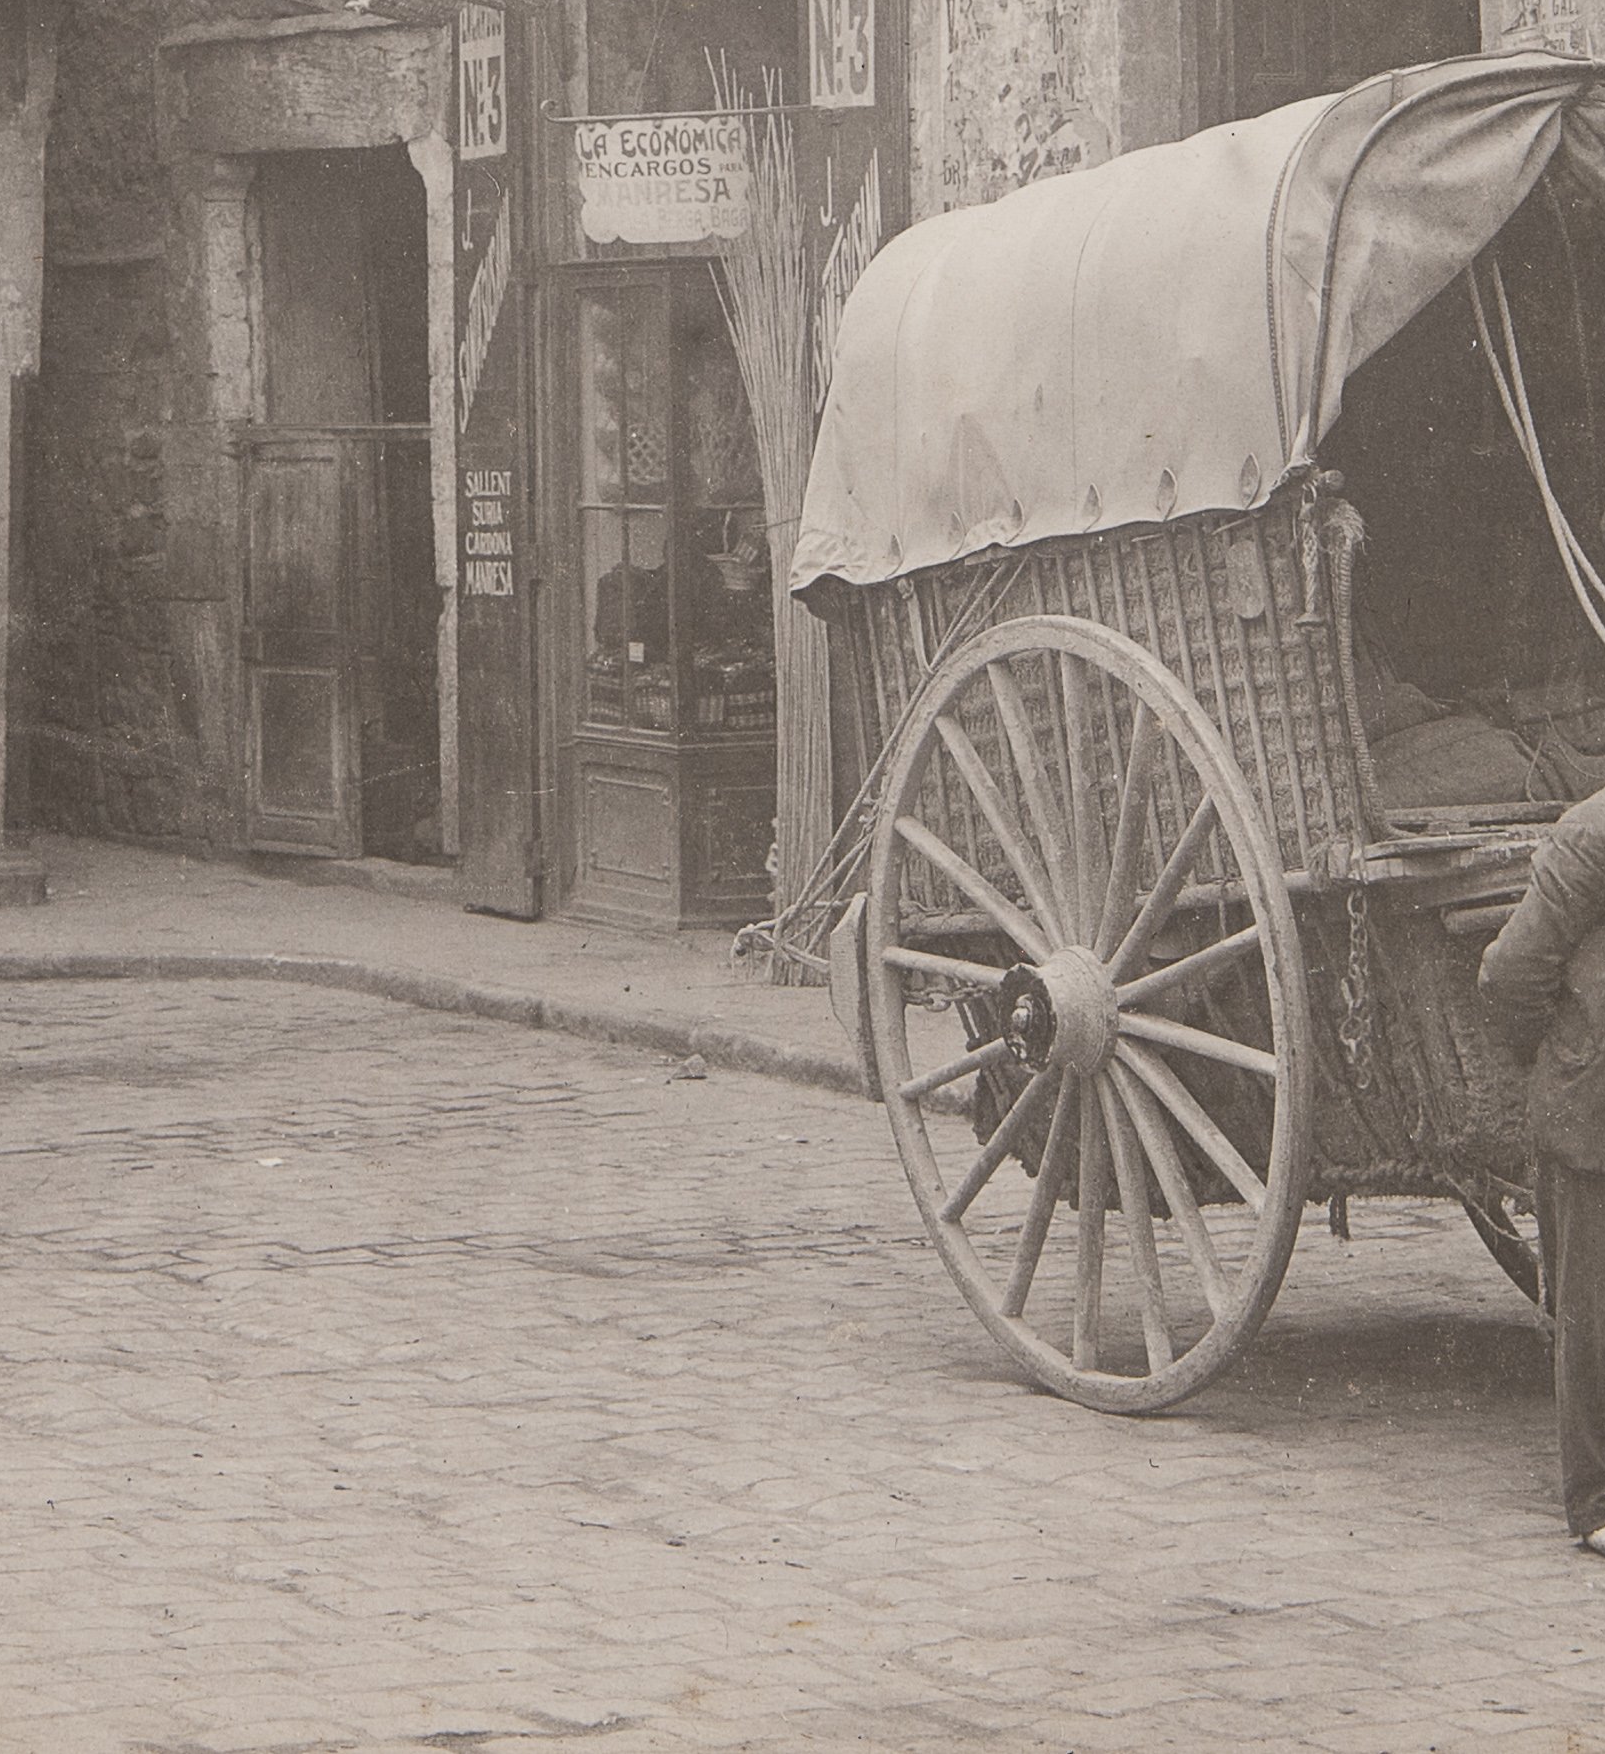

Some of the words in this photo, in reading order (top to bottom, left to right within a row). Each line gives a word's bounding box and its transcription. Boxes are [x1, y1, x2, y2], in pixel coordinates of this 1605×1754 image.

[578, 132, 608, 161] LA
[585, 157, 712, 179] ENCARGOS
[465, 469, 513, 498] SALLENT
